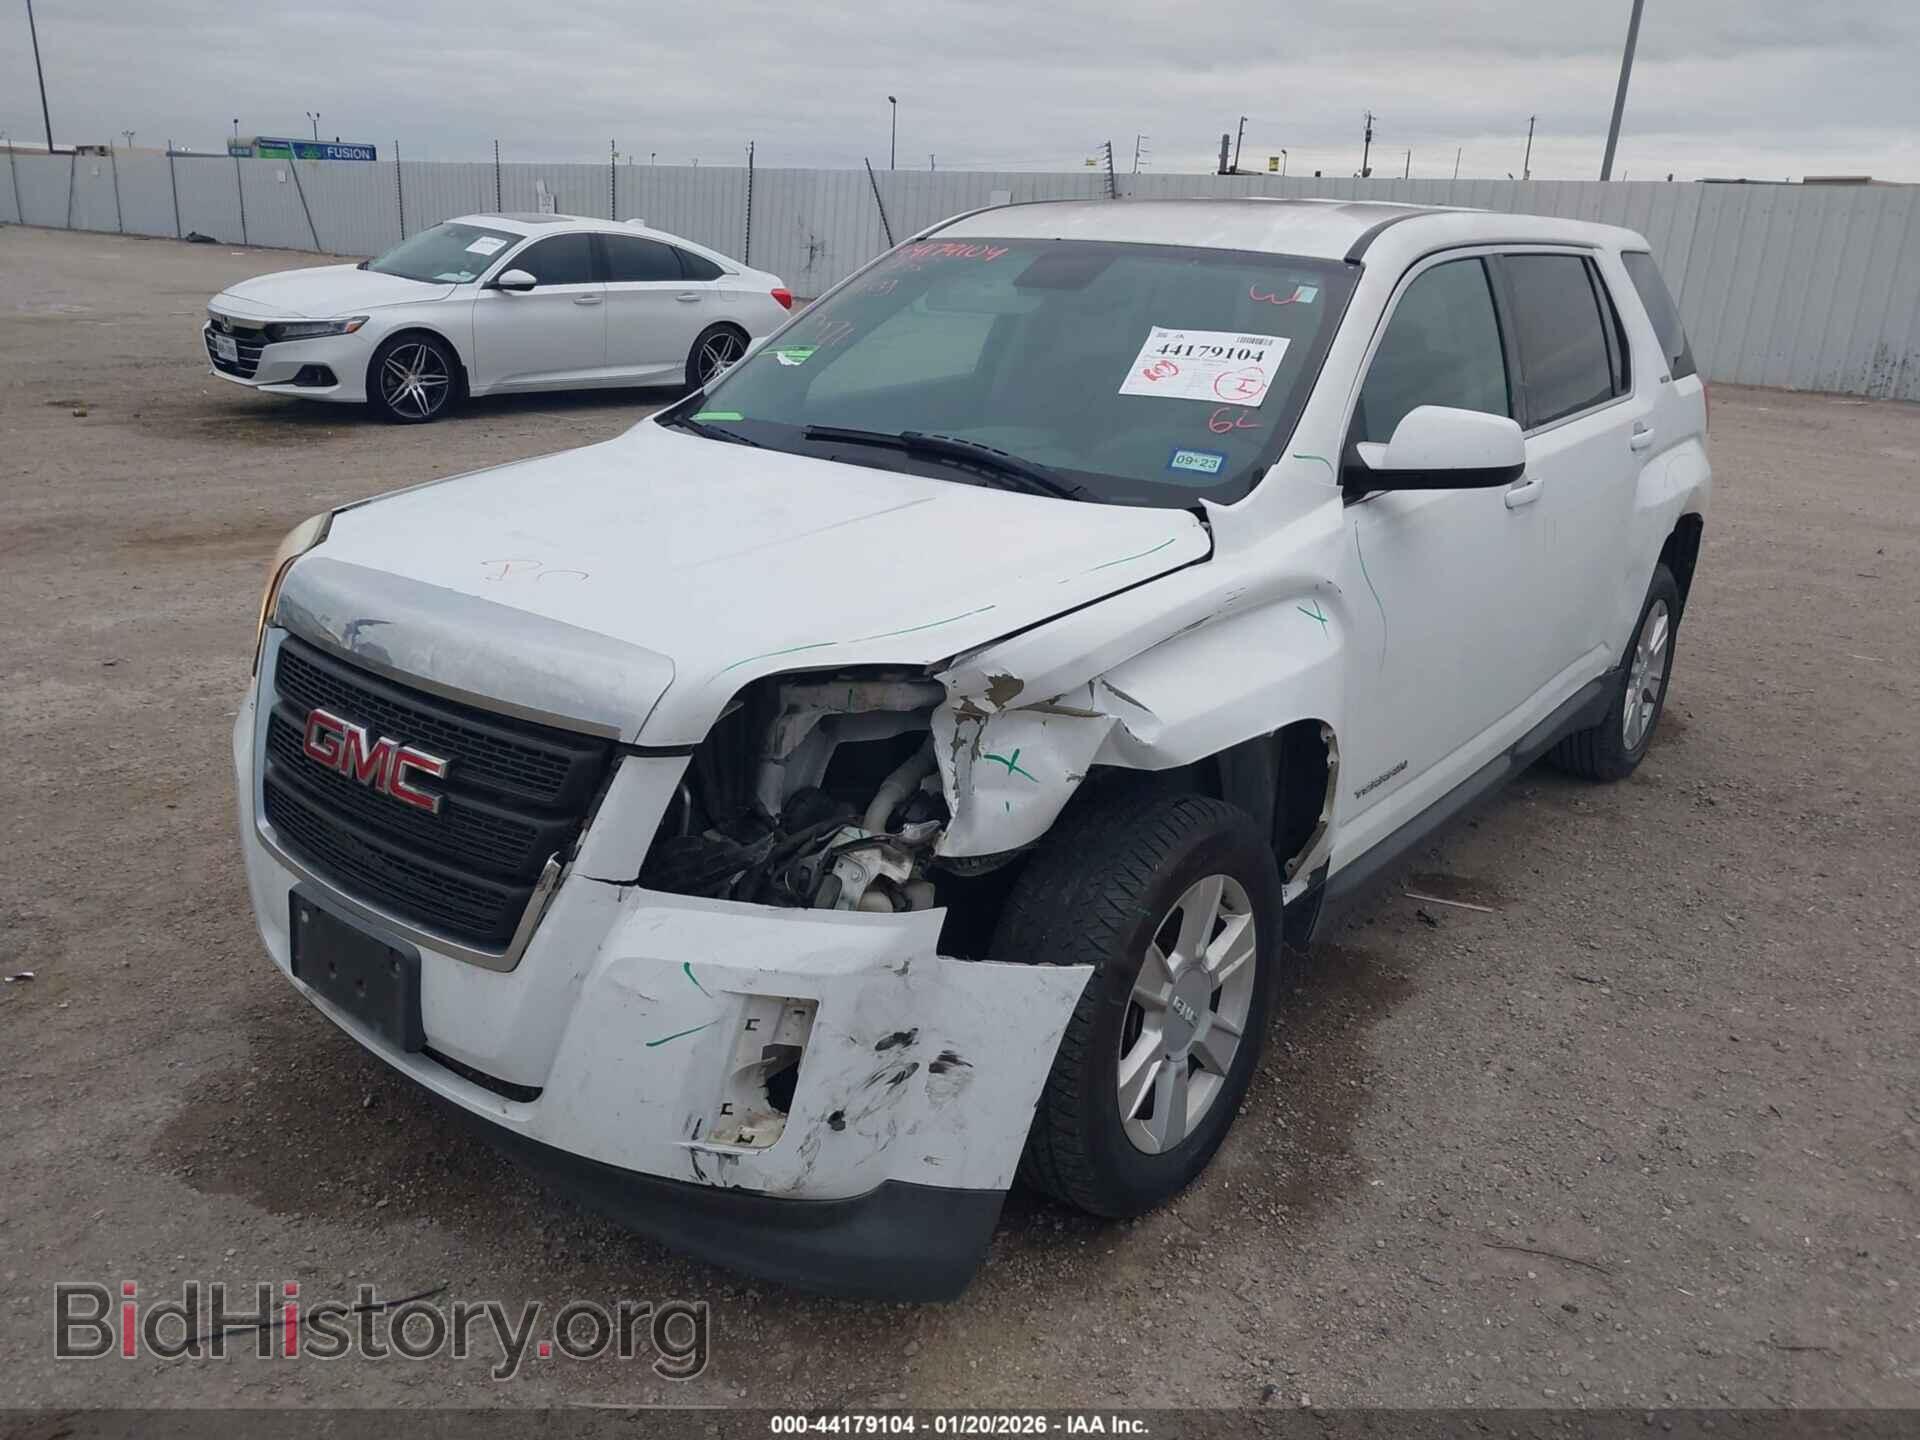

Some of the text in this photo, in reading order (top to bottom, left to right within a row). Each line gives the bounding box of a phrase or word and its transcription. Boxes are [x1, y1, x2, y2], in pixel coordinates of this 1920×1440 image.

[327, 147, 371, 160] FUSION
[1156, 344, 1265, 362] 44179104
[303, 708, 450, 815] GMC
